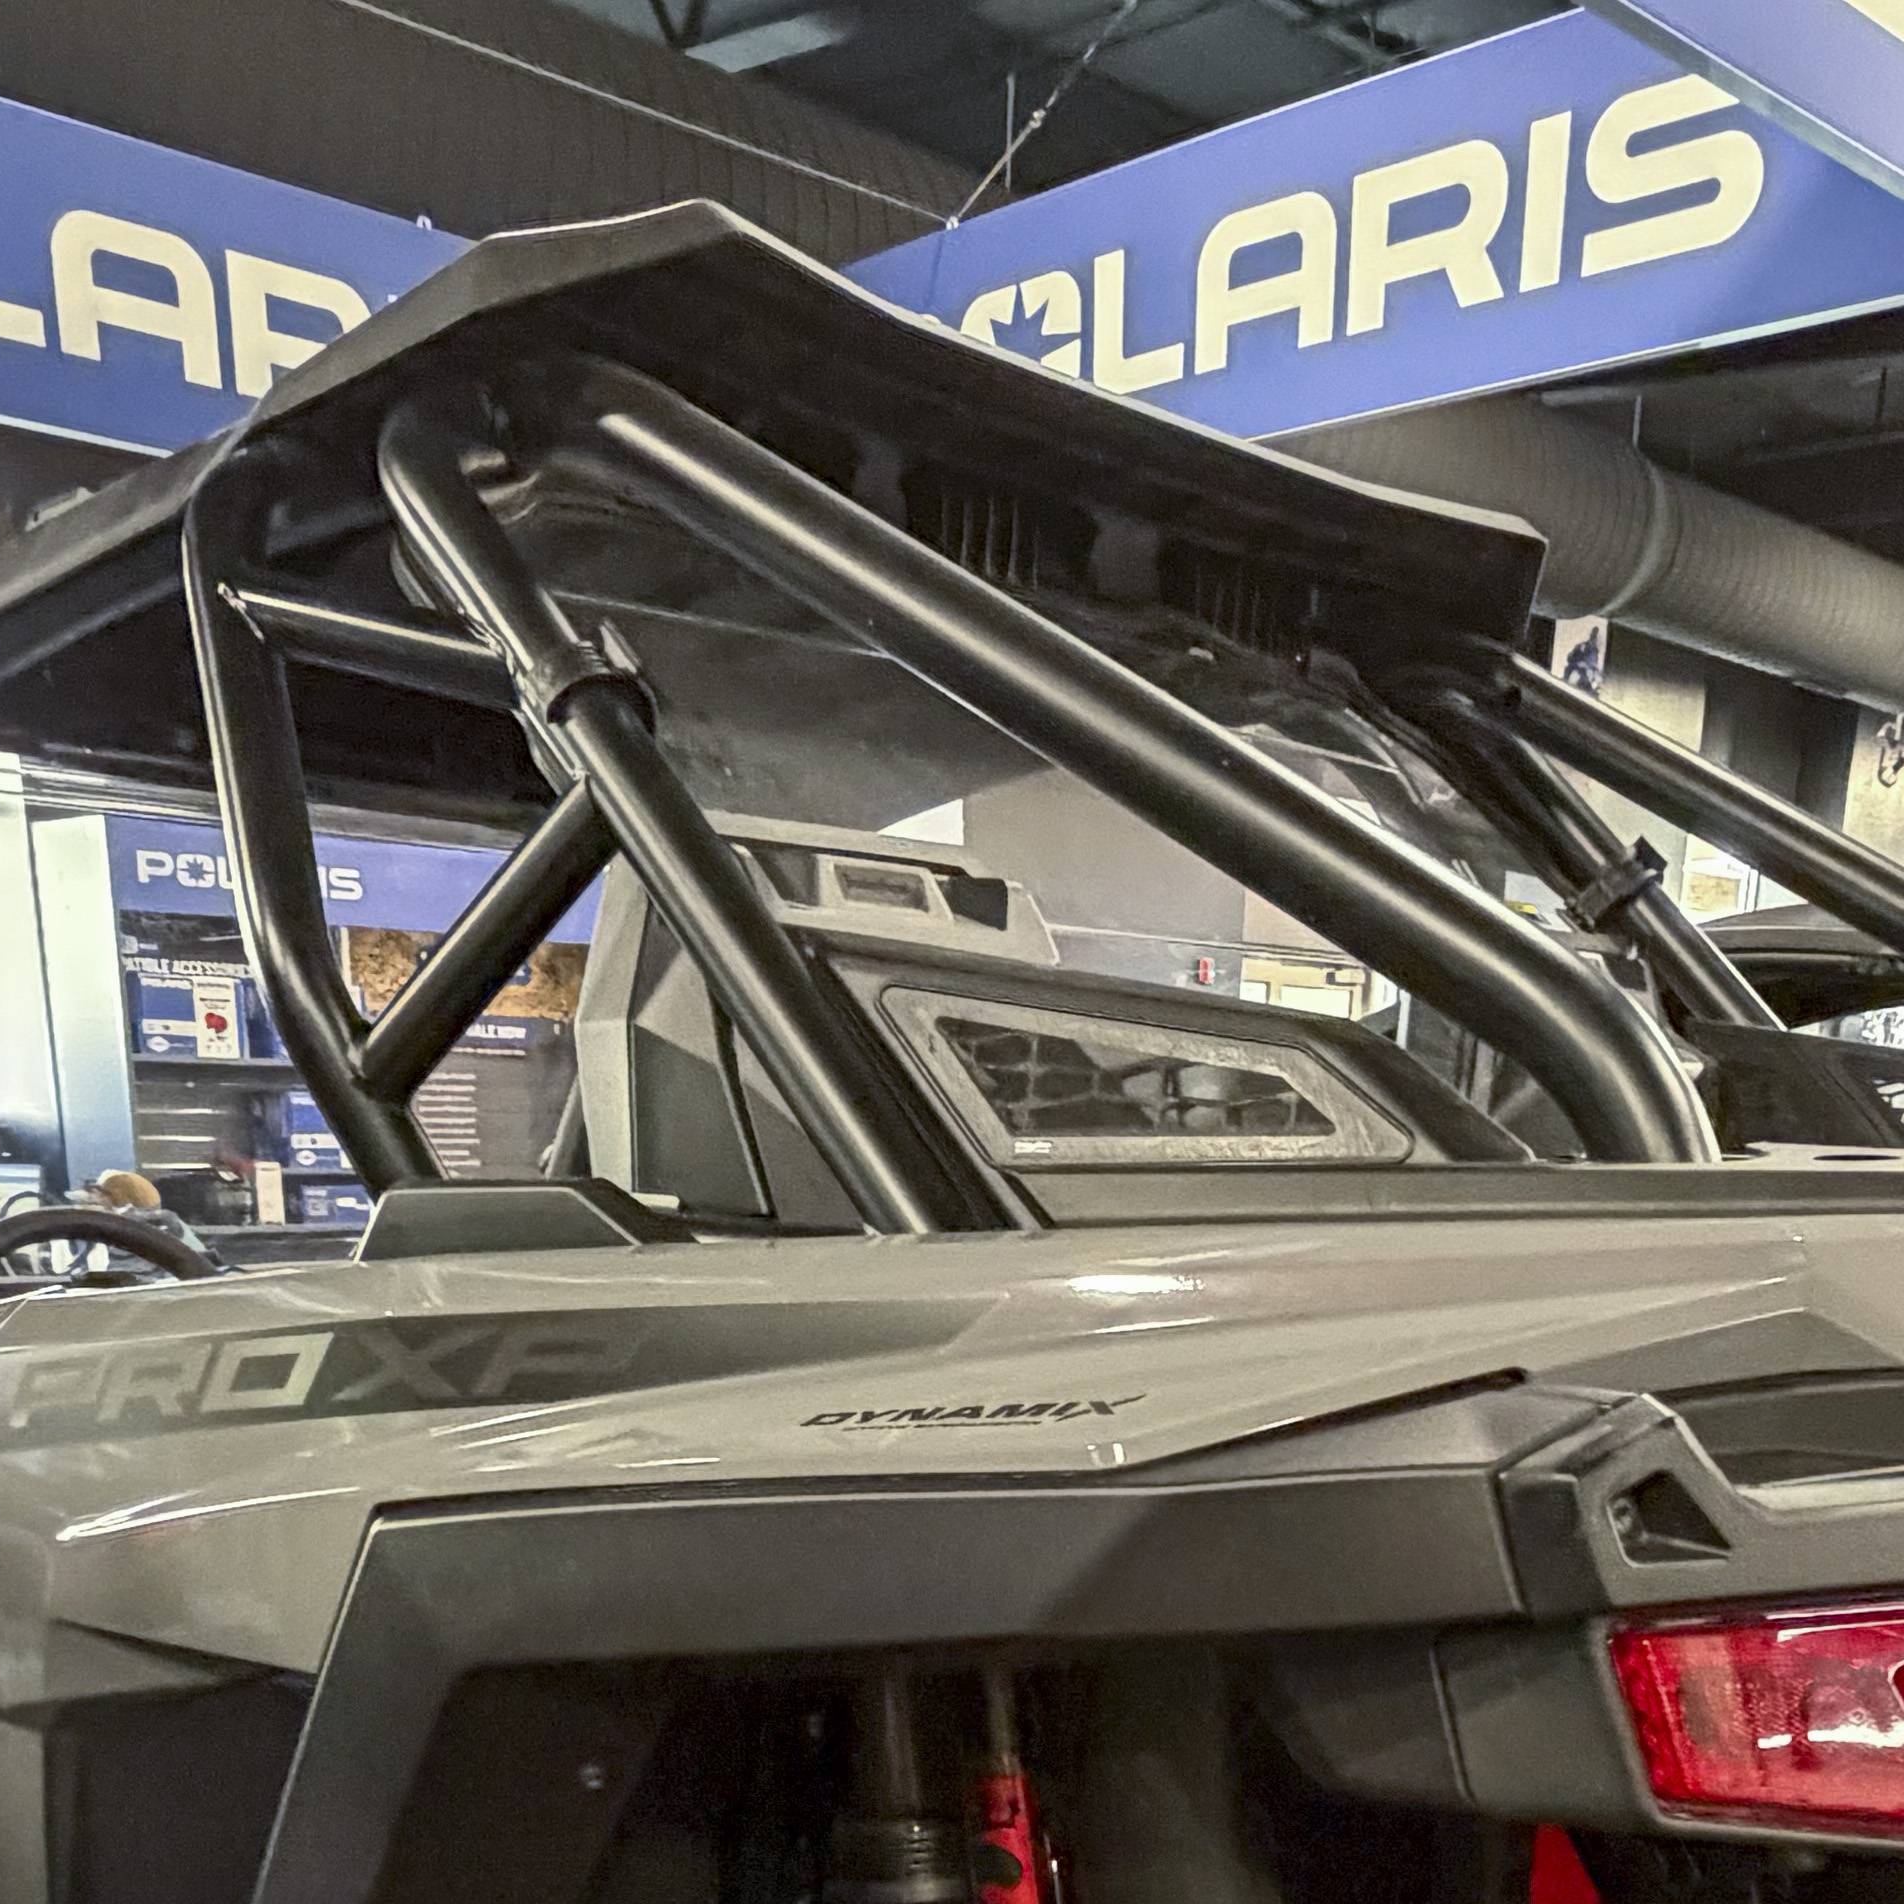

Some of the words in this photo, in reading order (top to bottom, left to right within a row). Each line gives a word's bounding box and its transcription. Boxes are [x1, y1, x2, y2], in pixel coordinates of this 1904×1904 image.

[922, 73, 1764, 394] OLARIS
[136, 849, 364, 901] POLIS
[800, 1393, 1147, 1427] DYNAMIX
